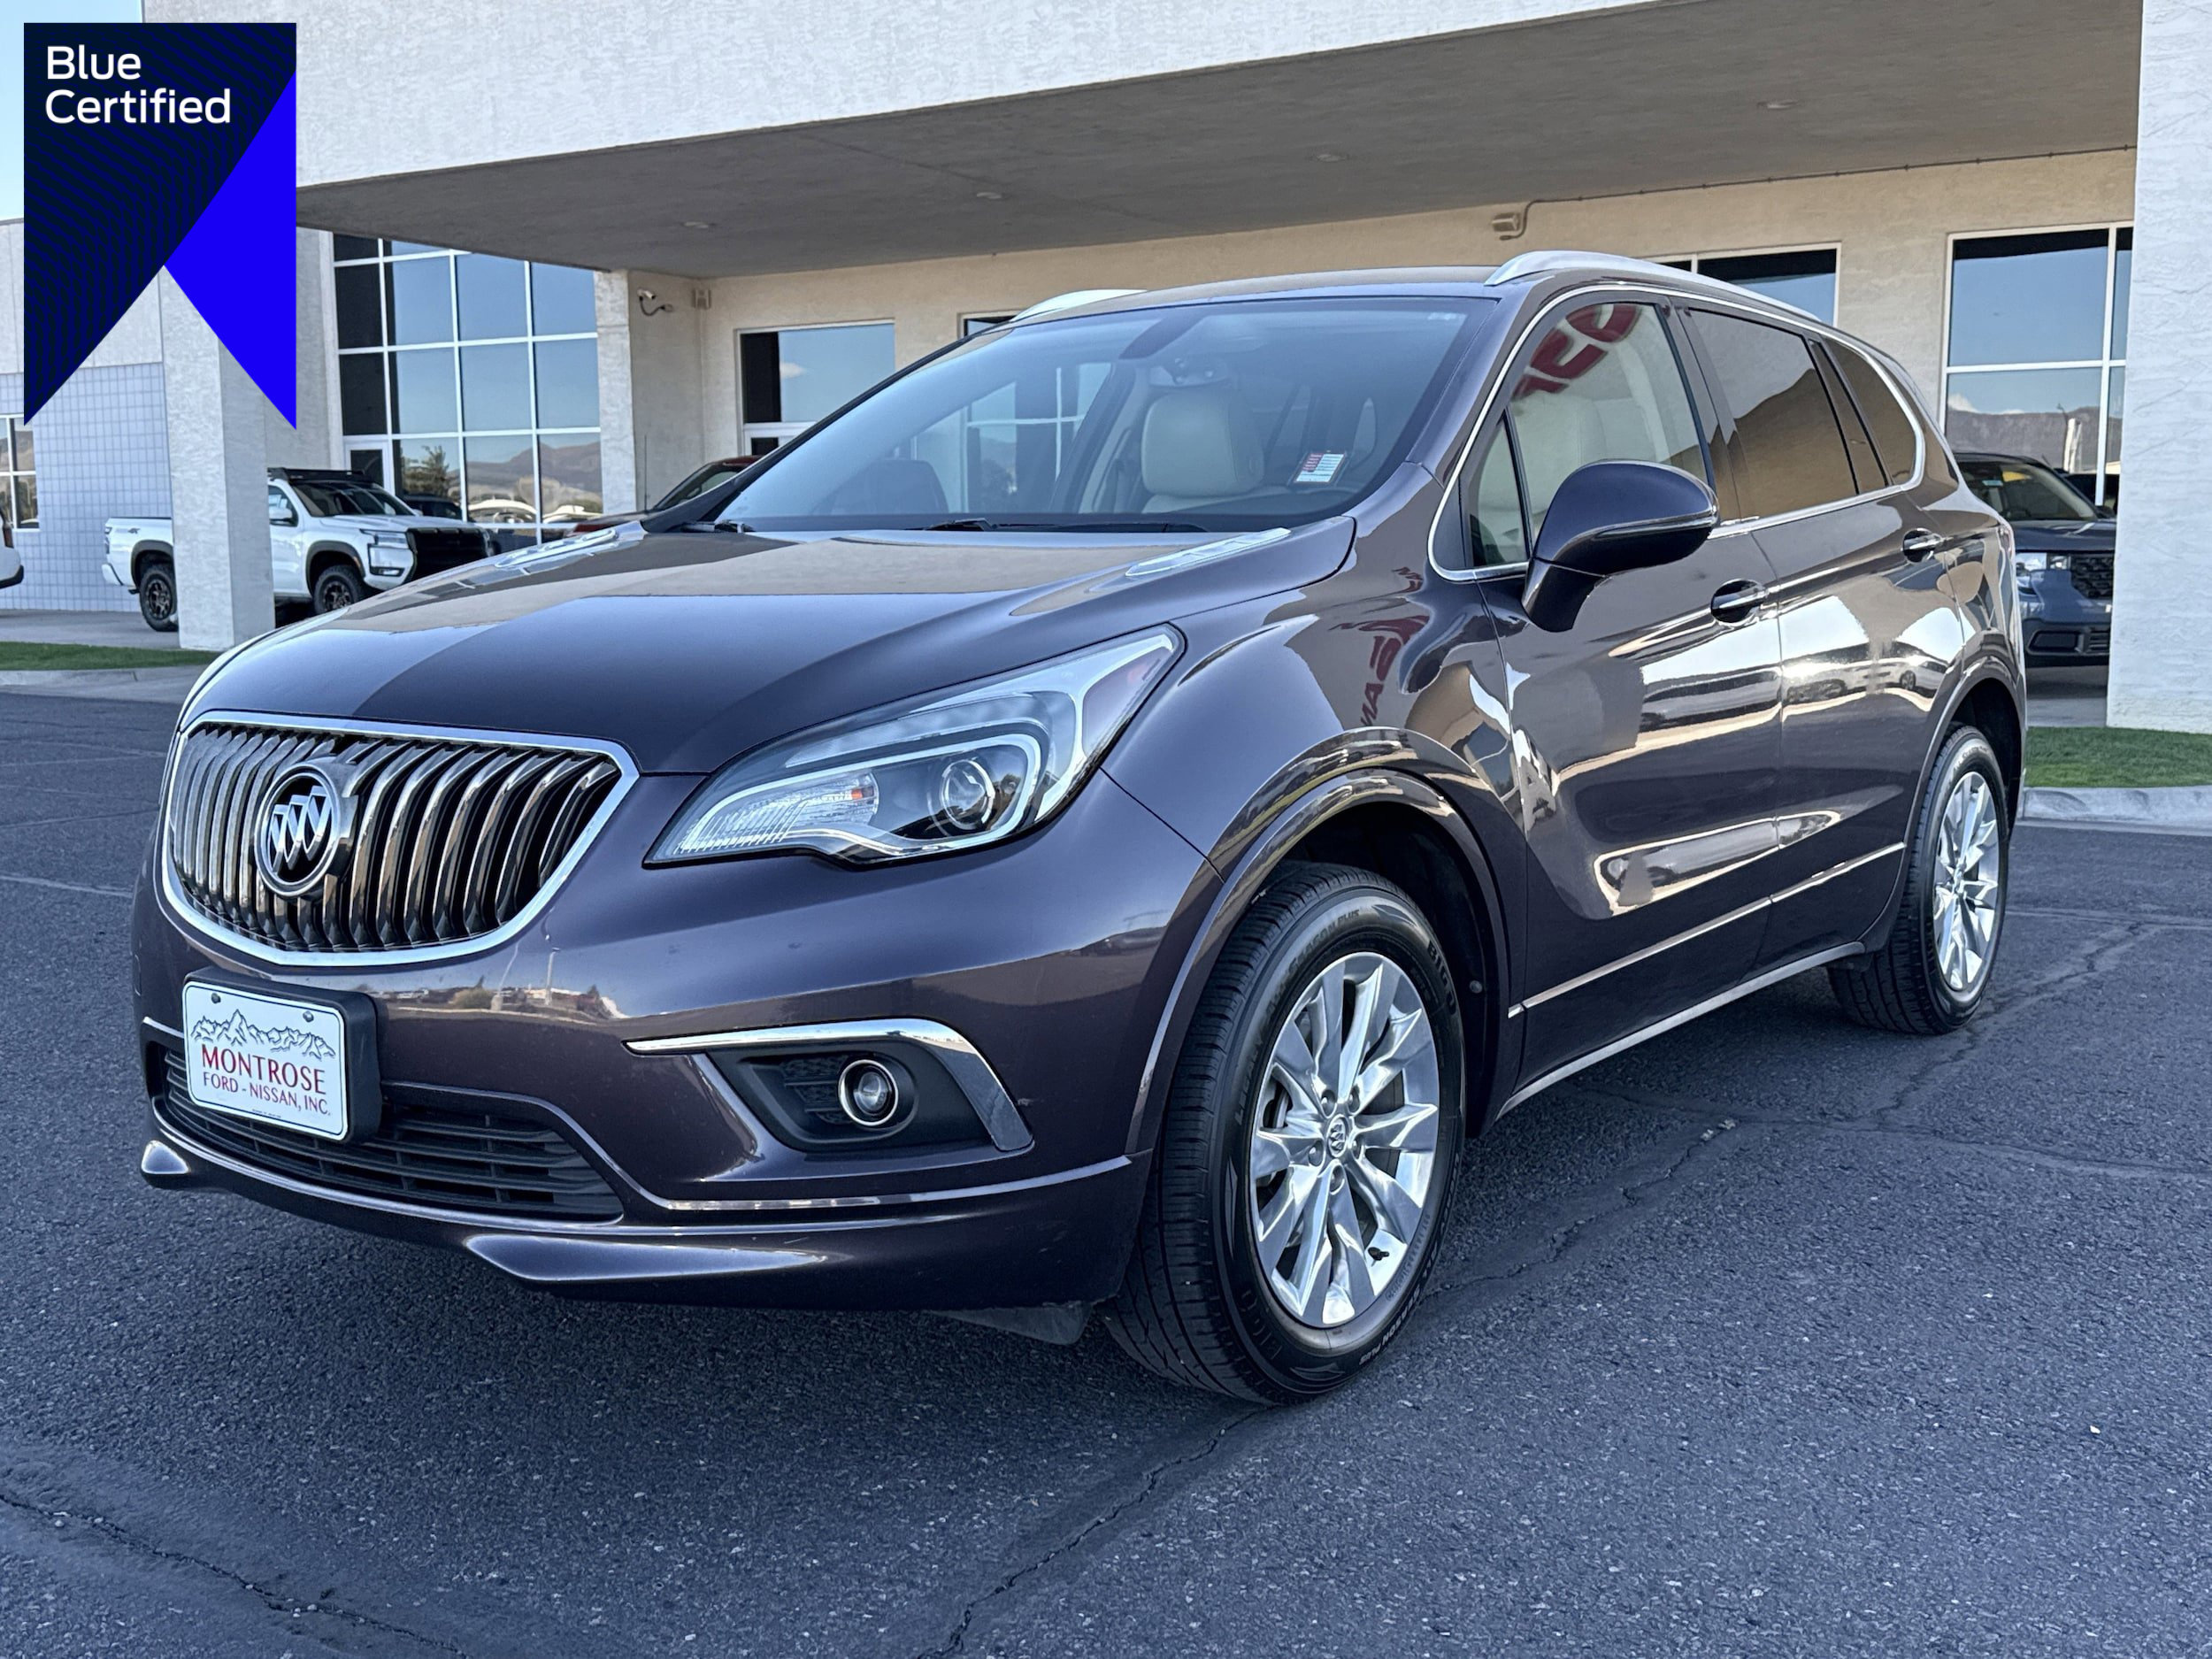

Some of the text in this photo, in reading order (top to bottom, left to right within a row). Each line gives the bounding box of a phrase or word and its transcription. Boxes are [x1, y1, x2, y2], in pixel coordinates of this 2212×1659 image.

[202, 1044, 326, 1094] MONTROSE
[204, 1071, 238, 1093] FORD
[250, 1082, 302, 1111] NISSAN,
